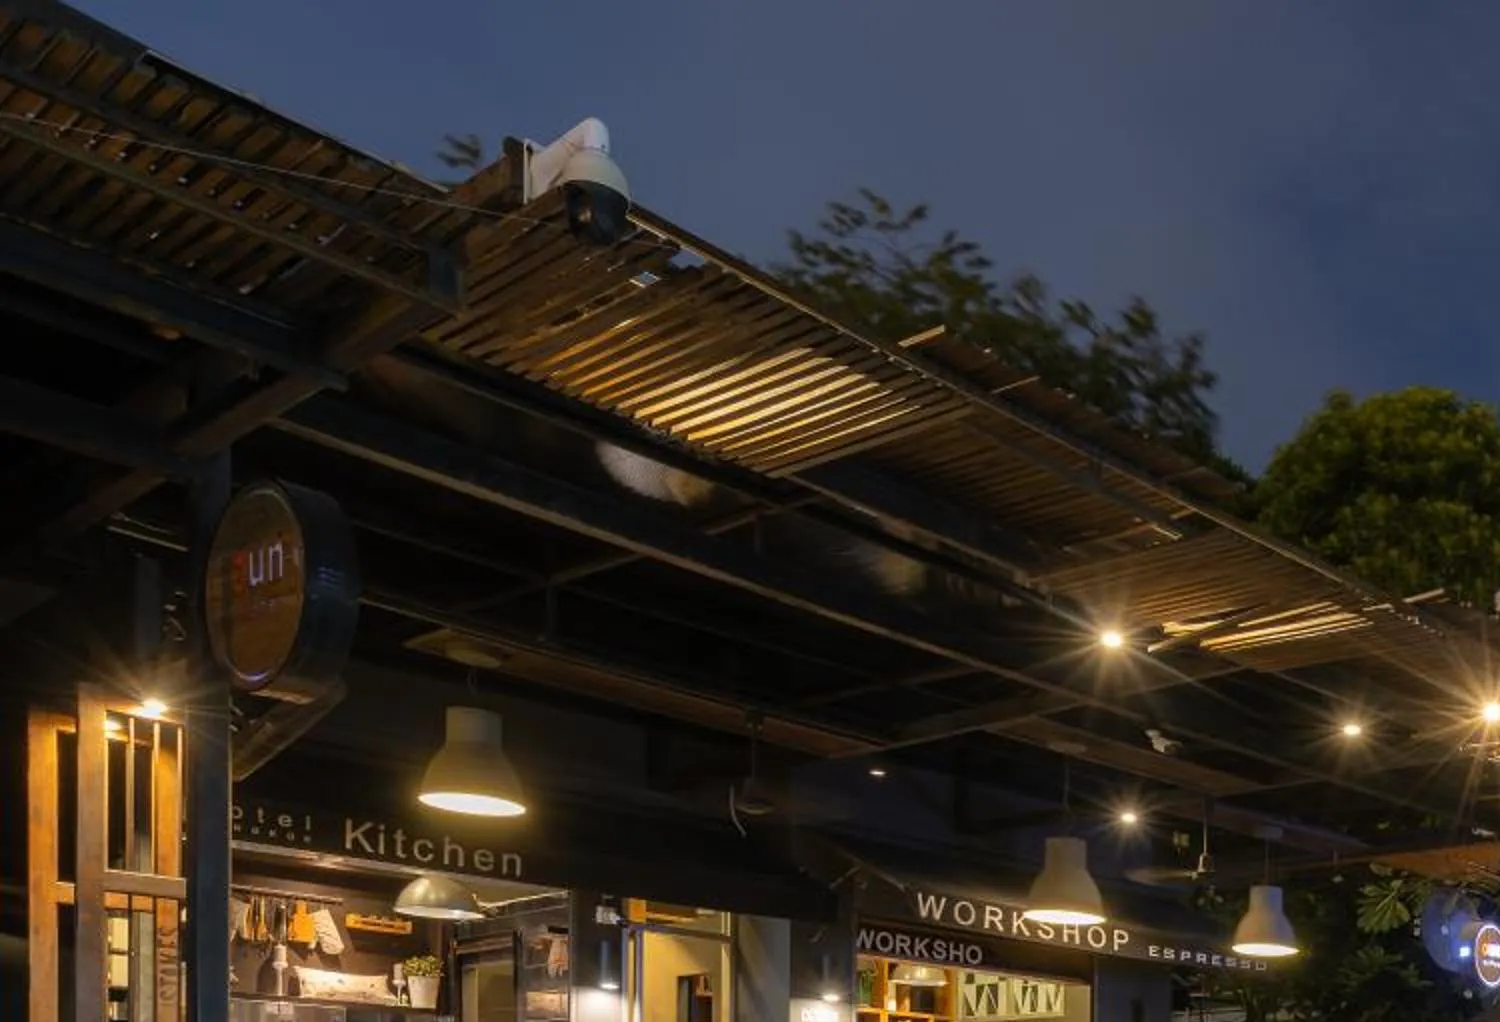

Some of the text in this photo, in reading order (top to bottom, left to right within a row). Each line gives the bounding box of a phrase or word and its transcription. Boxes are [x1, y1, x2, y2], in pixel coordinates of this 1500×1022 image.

[232, 805, 311, 832] otel
[345, 817, 522, 877] Kitchen
[856, 929, 983, 964] WORKSHO
[917, 891, 1267, 971] WORKSHOP ESPRESSO
